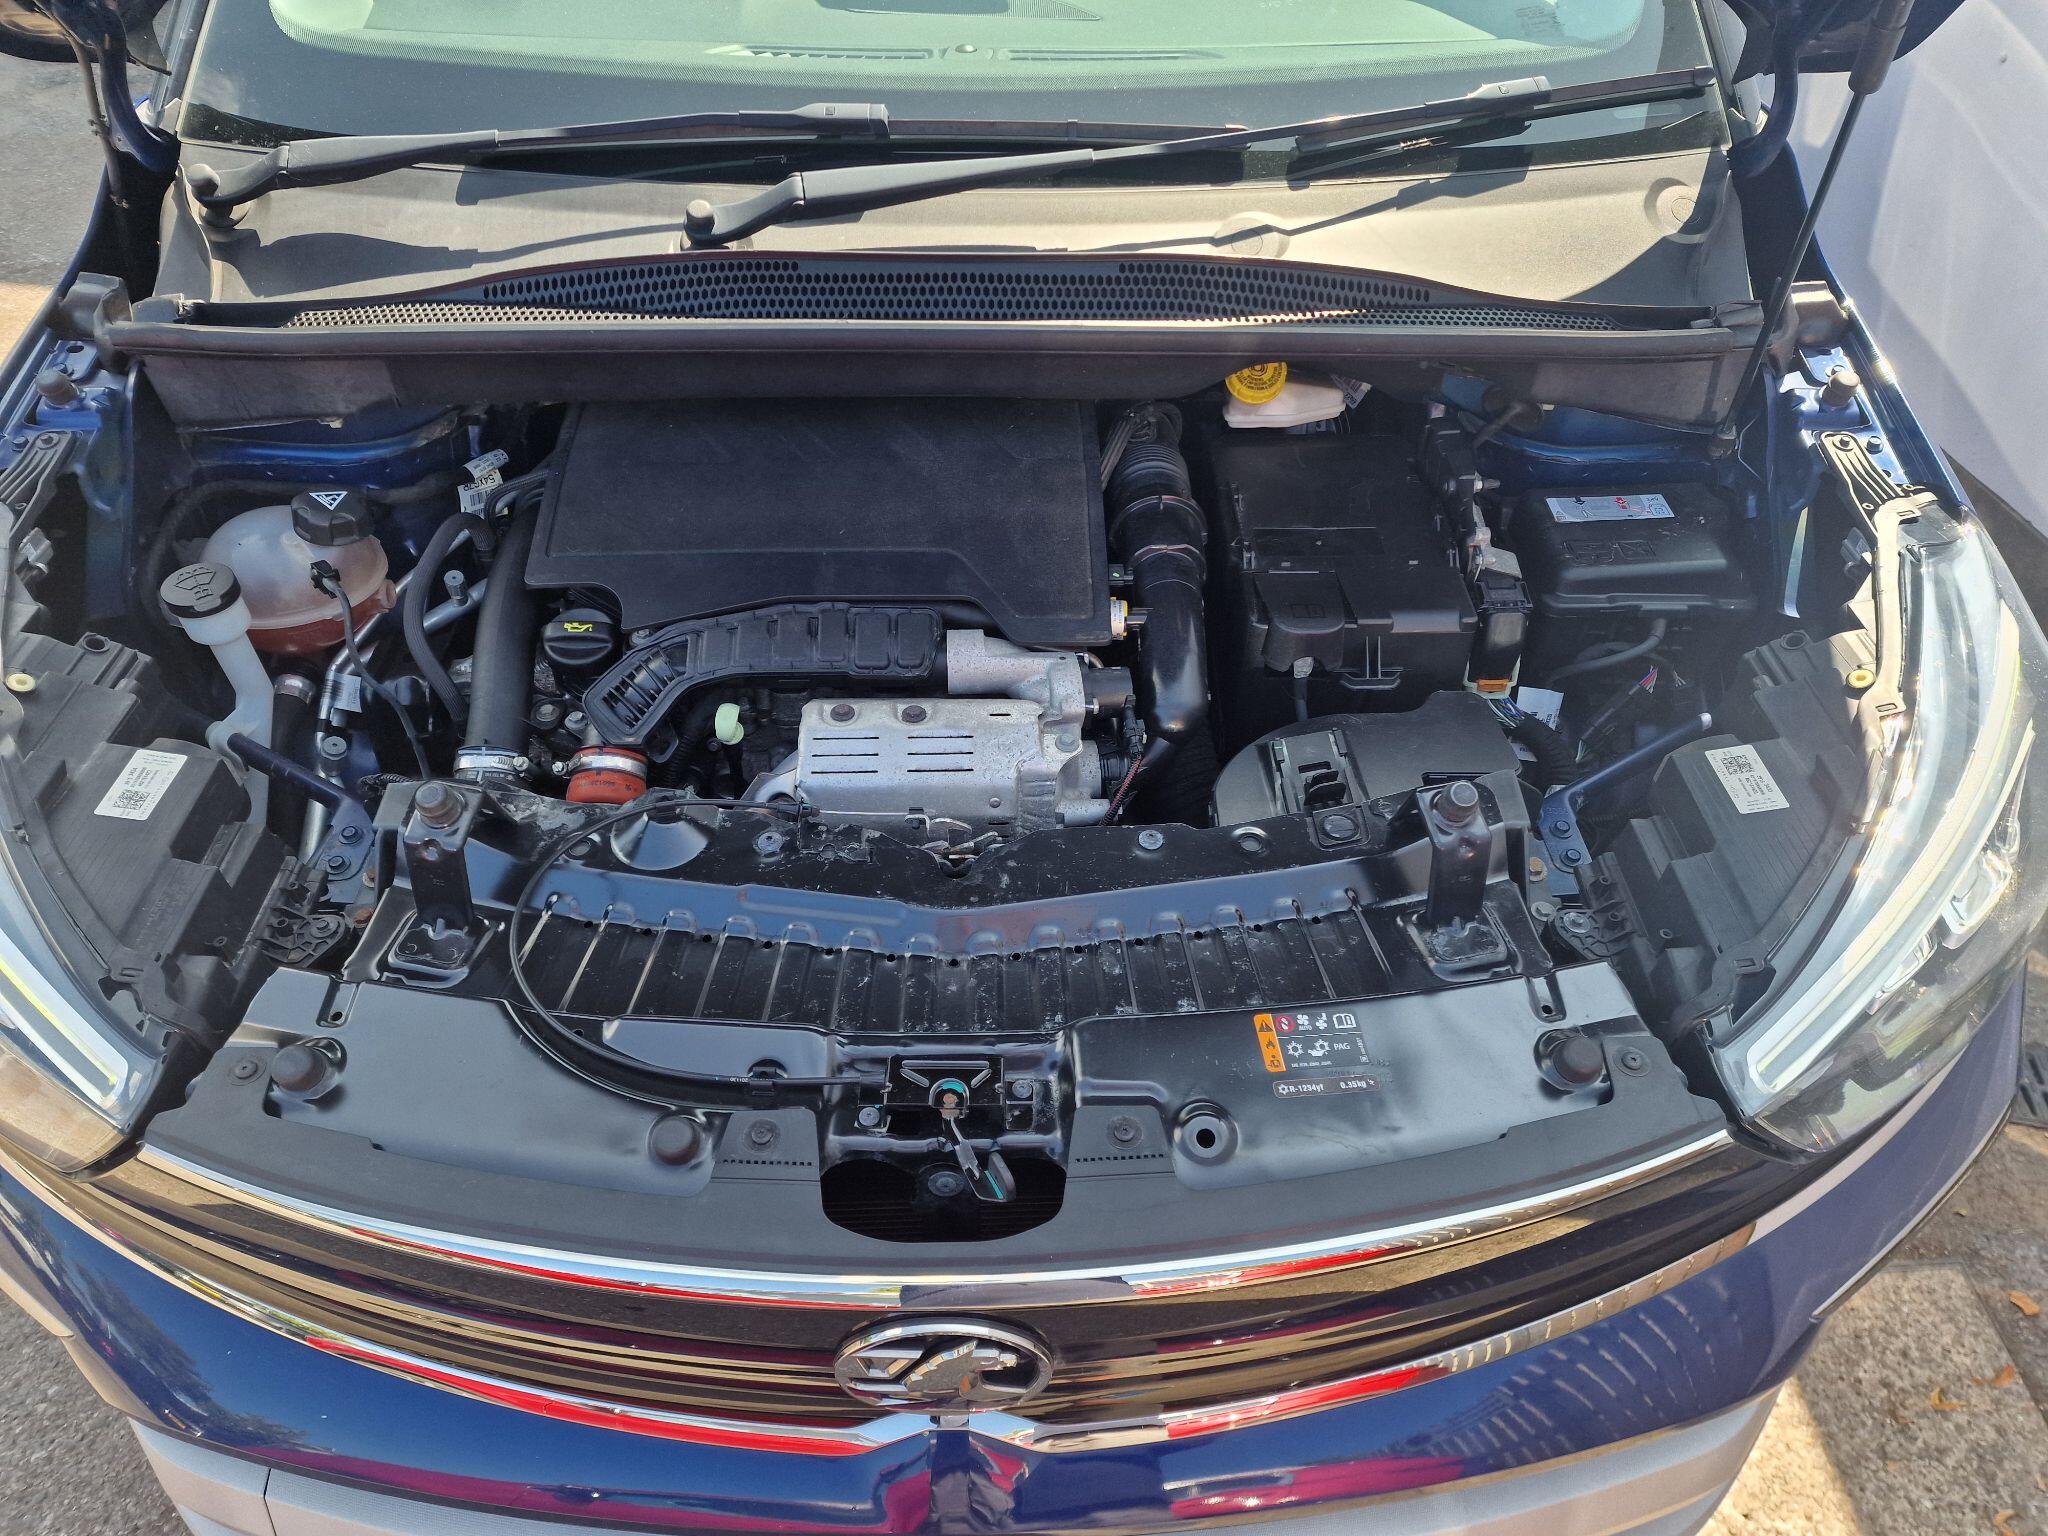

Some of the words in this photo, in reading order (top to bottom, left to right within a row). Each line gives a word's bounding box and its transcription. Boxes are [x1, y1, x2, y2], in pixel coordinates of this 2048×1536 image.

[1333, 1042, 1351, 1050] PAG
[1289, 1083, 1324, 1093] R-1234yf
[1340, 1080, 1366, 1089] 0.35kg
